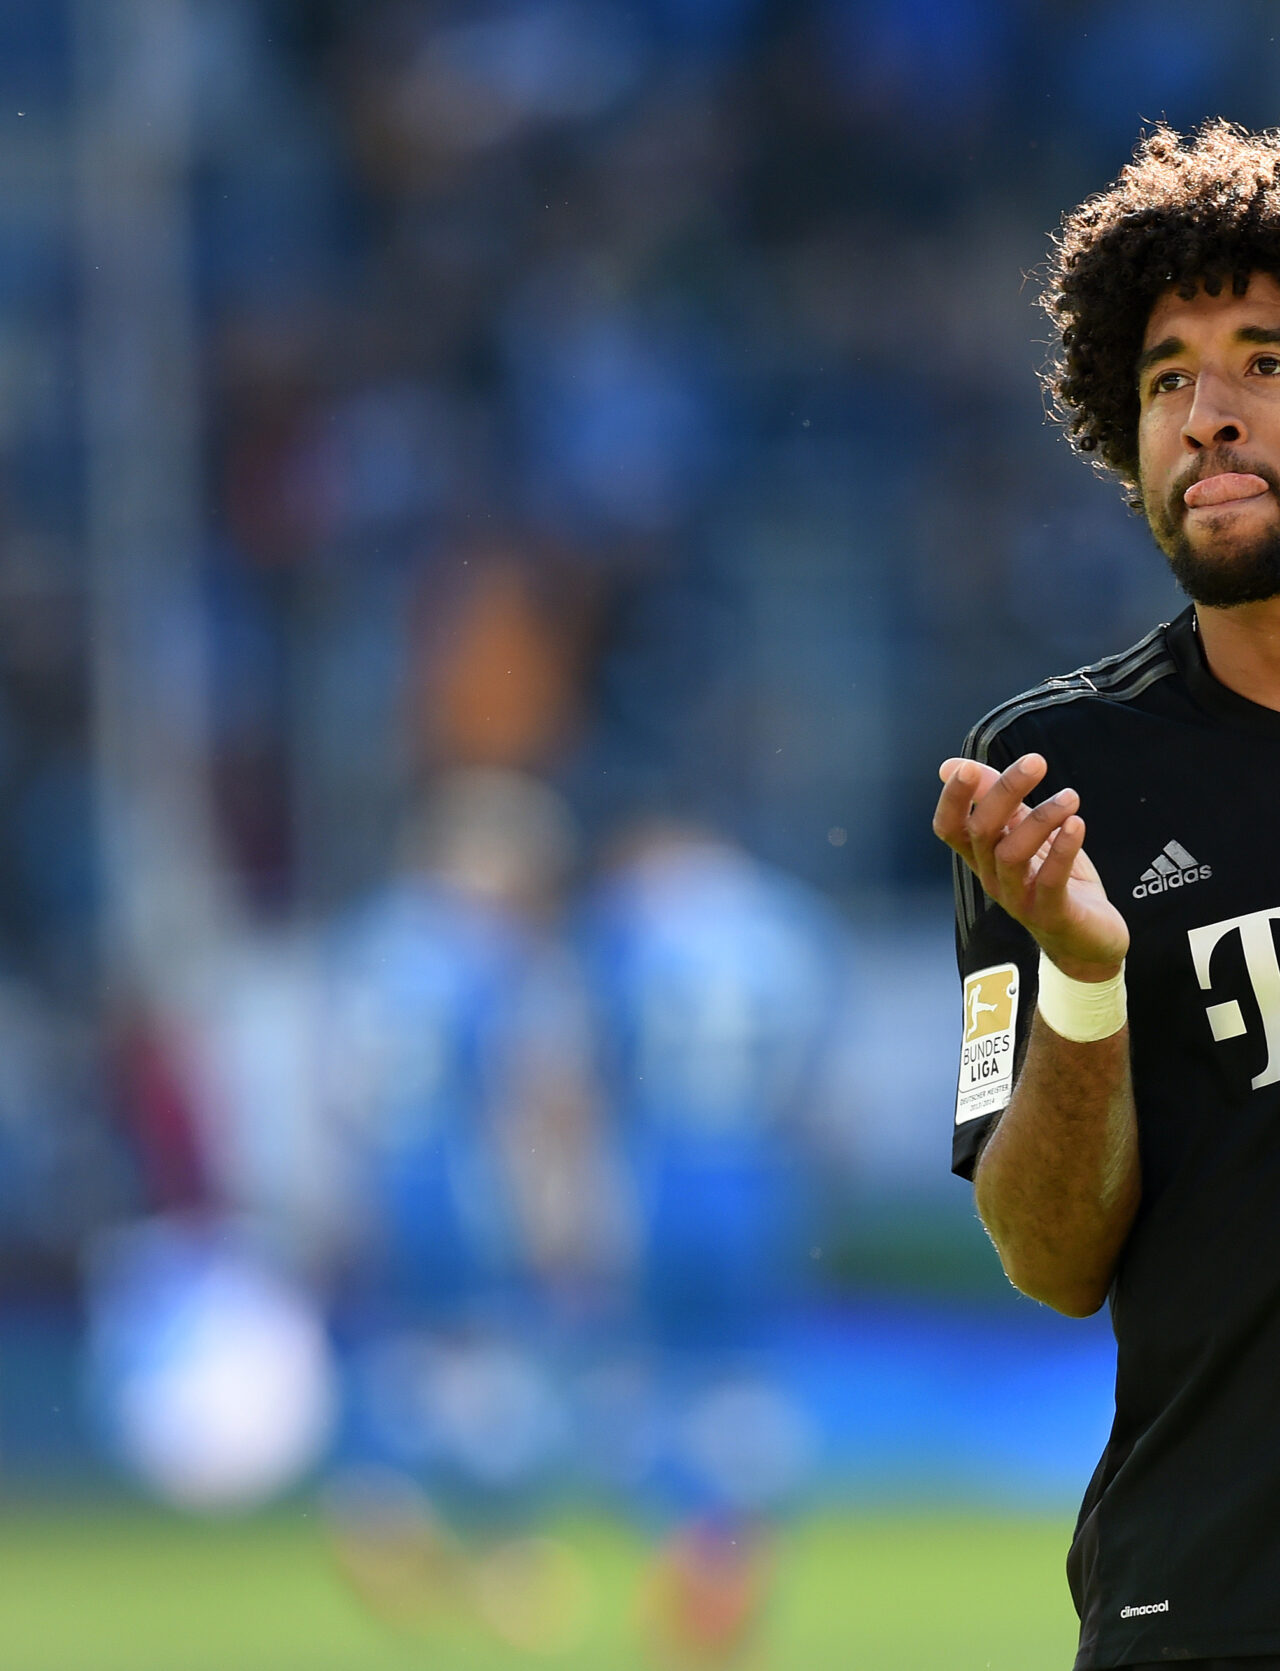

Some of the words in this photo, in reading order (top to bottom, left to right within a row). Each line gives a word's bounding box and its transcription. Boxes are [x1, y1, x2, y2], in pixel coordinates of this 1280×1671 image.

[1132, 864, 1213, 899] adidas
[963, 1034, 1010, 1066] BUNDES
[971, 1057, 999, 1082] LIGA
